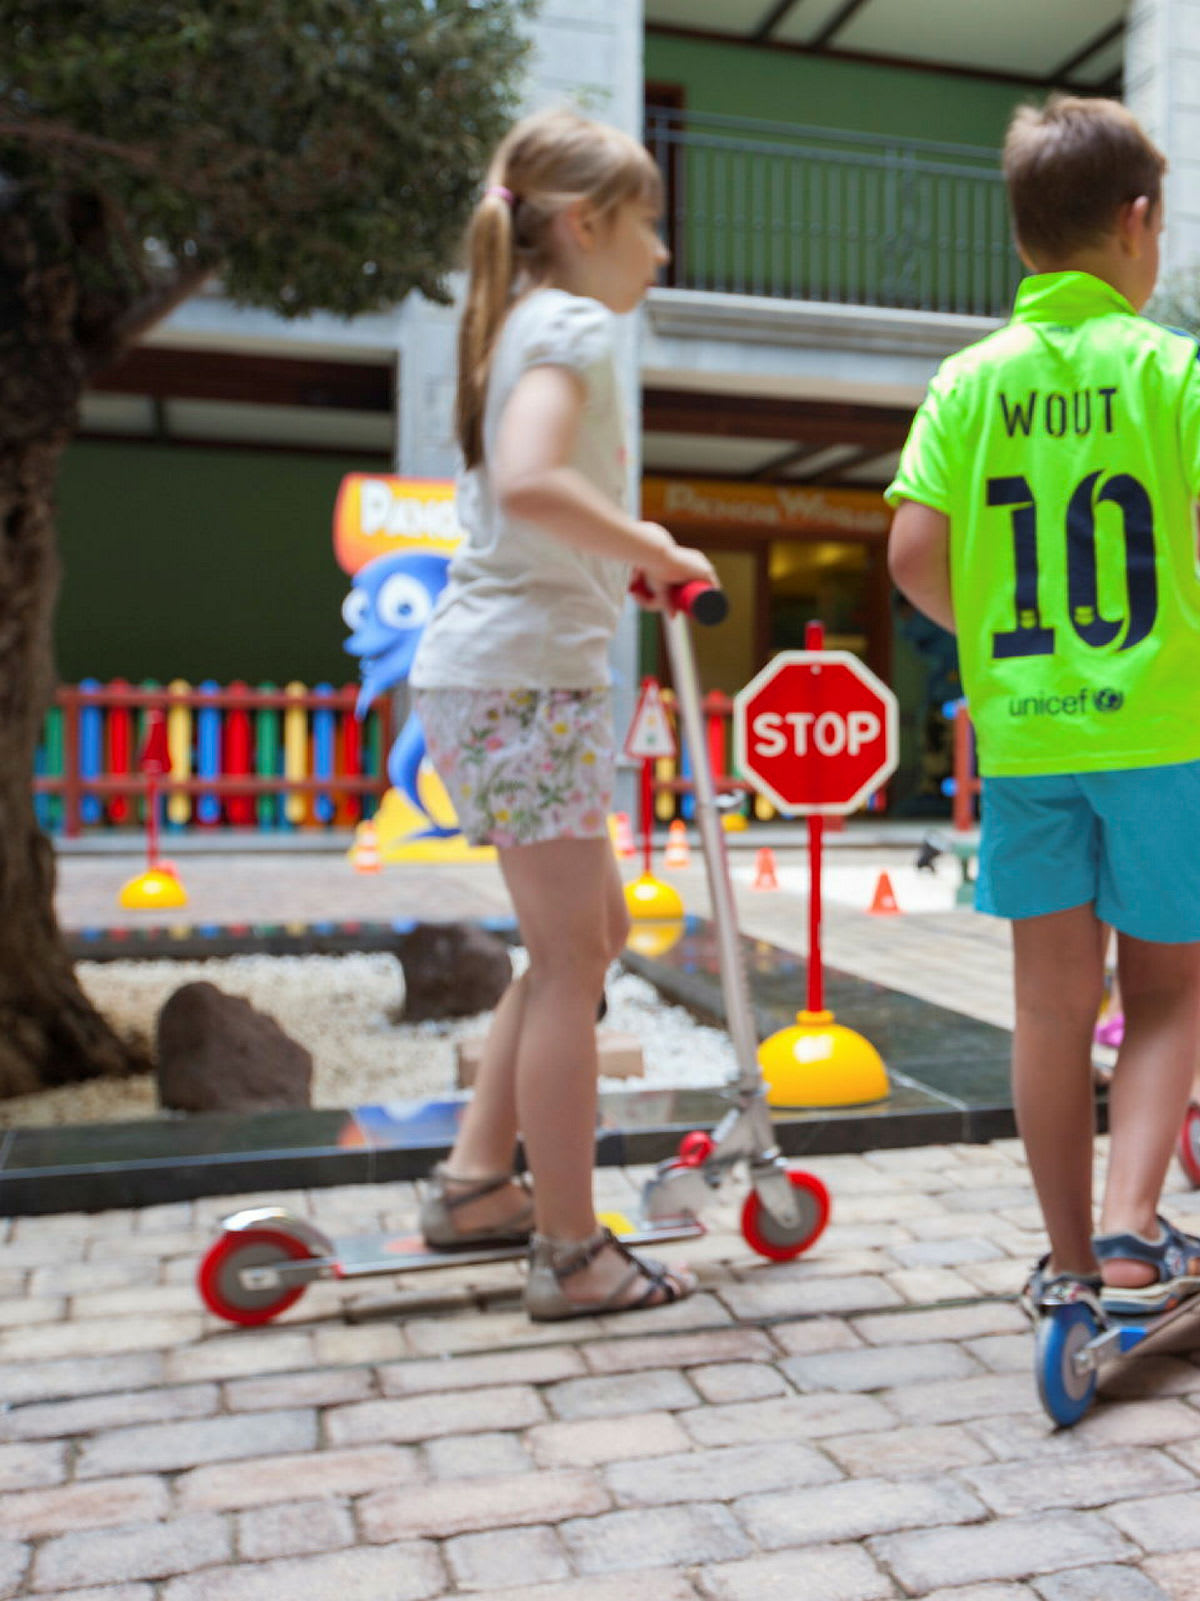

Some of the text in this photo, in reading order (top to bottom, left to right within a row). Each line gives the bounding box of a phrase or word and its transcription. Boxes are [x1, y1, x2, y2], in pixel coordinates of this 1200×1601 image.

[999, 387, 1118, 438] WOUT
[986, 470, 1158, 660] 10
[1009, 688, 1088, 716] unicef
[752, 711, 881, 758] STOP
